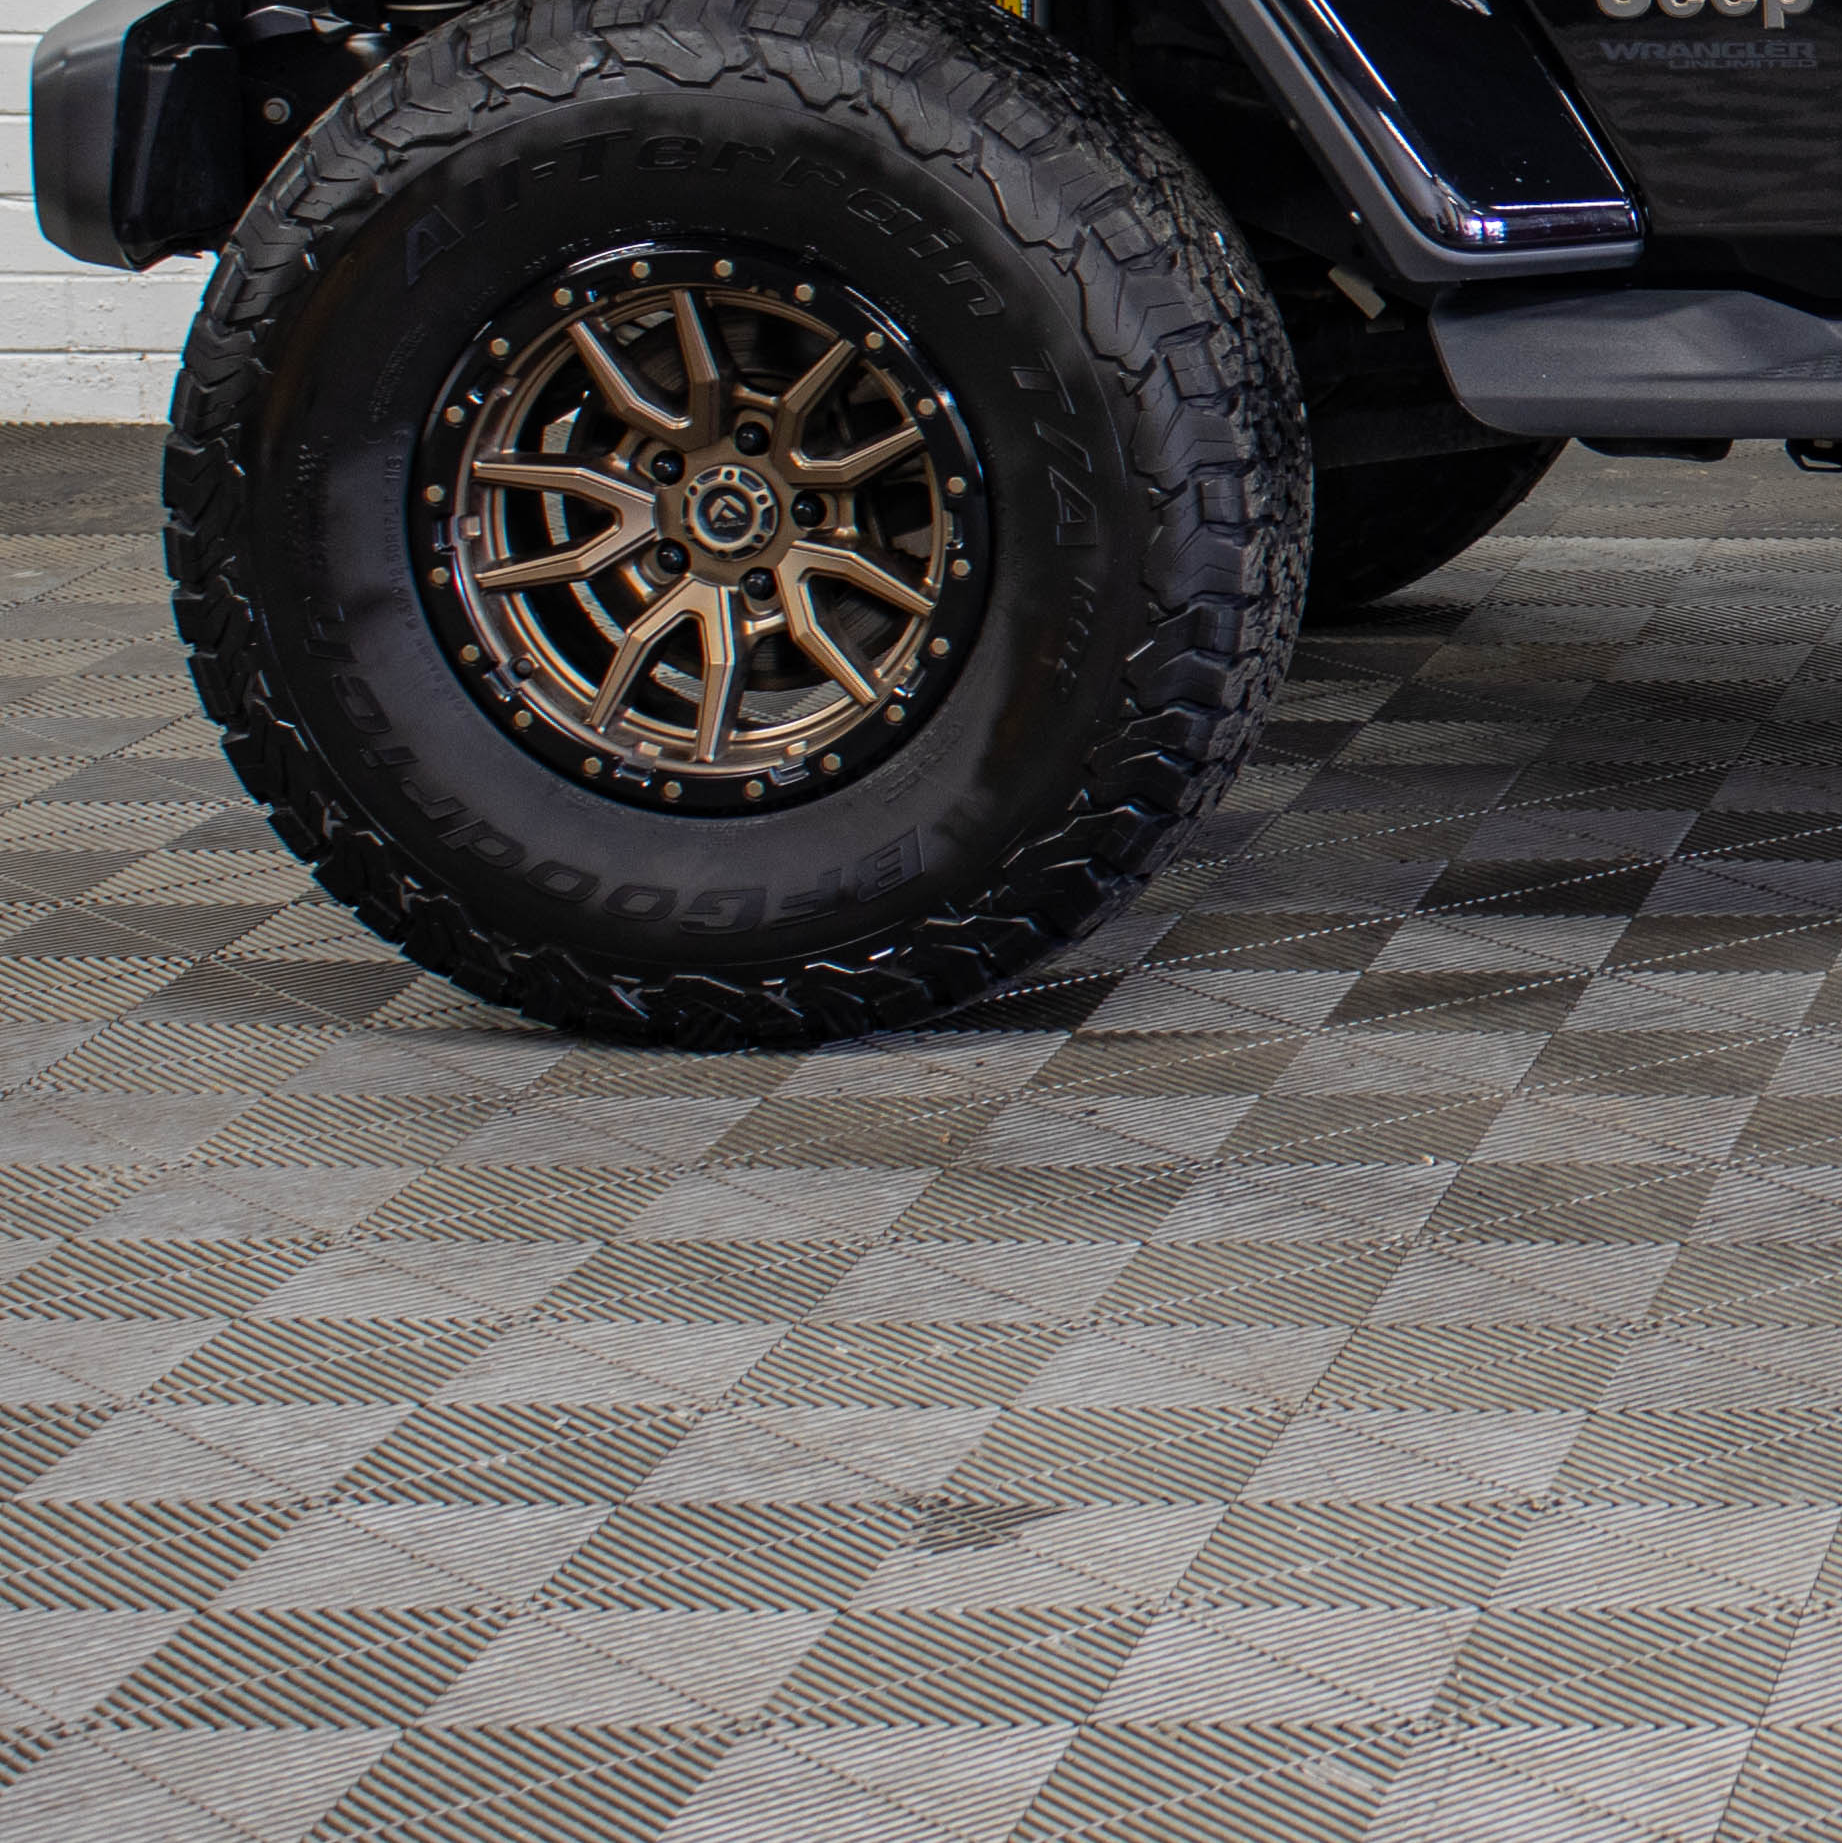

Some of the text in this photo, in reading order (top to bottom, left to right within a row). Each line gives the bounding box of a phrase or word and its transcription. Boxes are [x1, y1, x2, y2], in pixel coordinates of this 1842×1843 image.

[1600, 40, 1817, 60] WRANGLER
[1668, 60, 1817, 70] UNLIMITED
[1009, 350, 1100, 547] T/A
